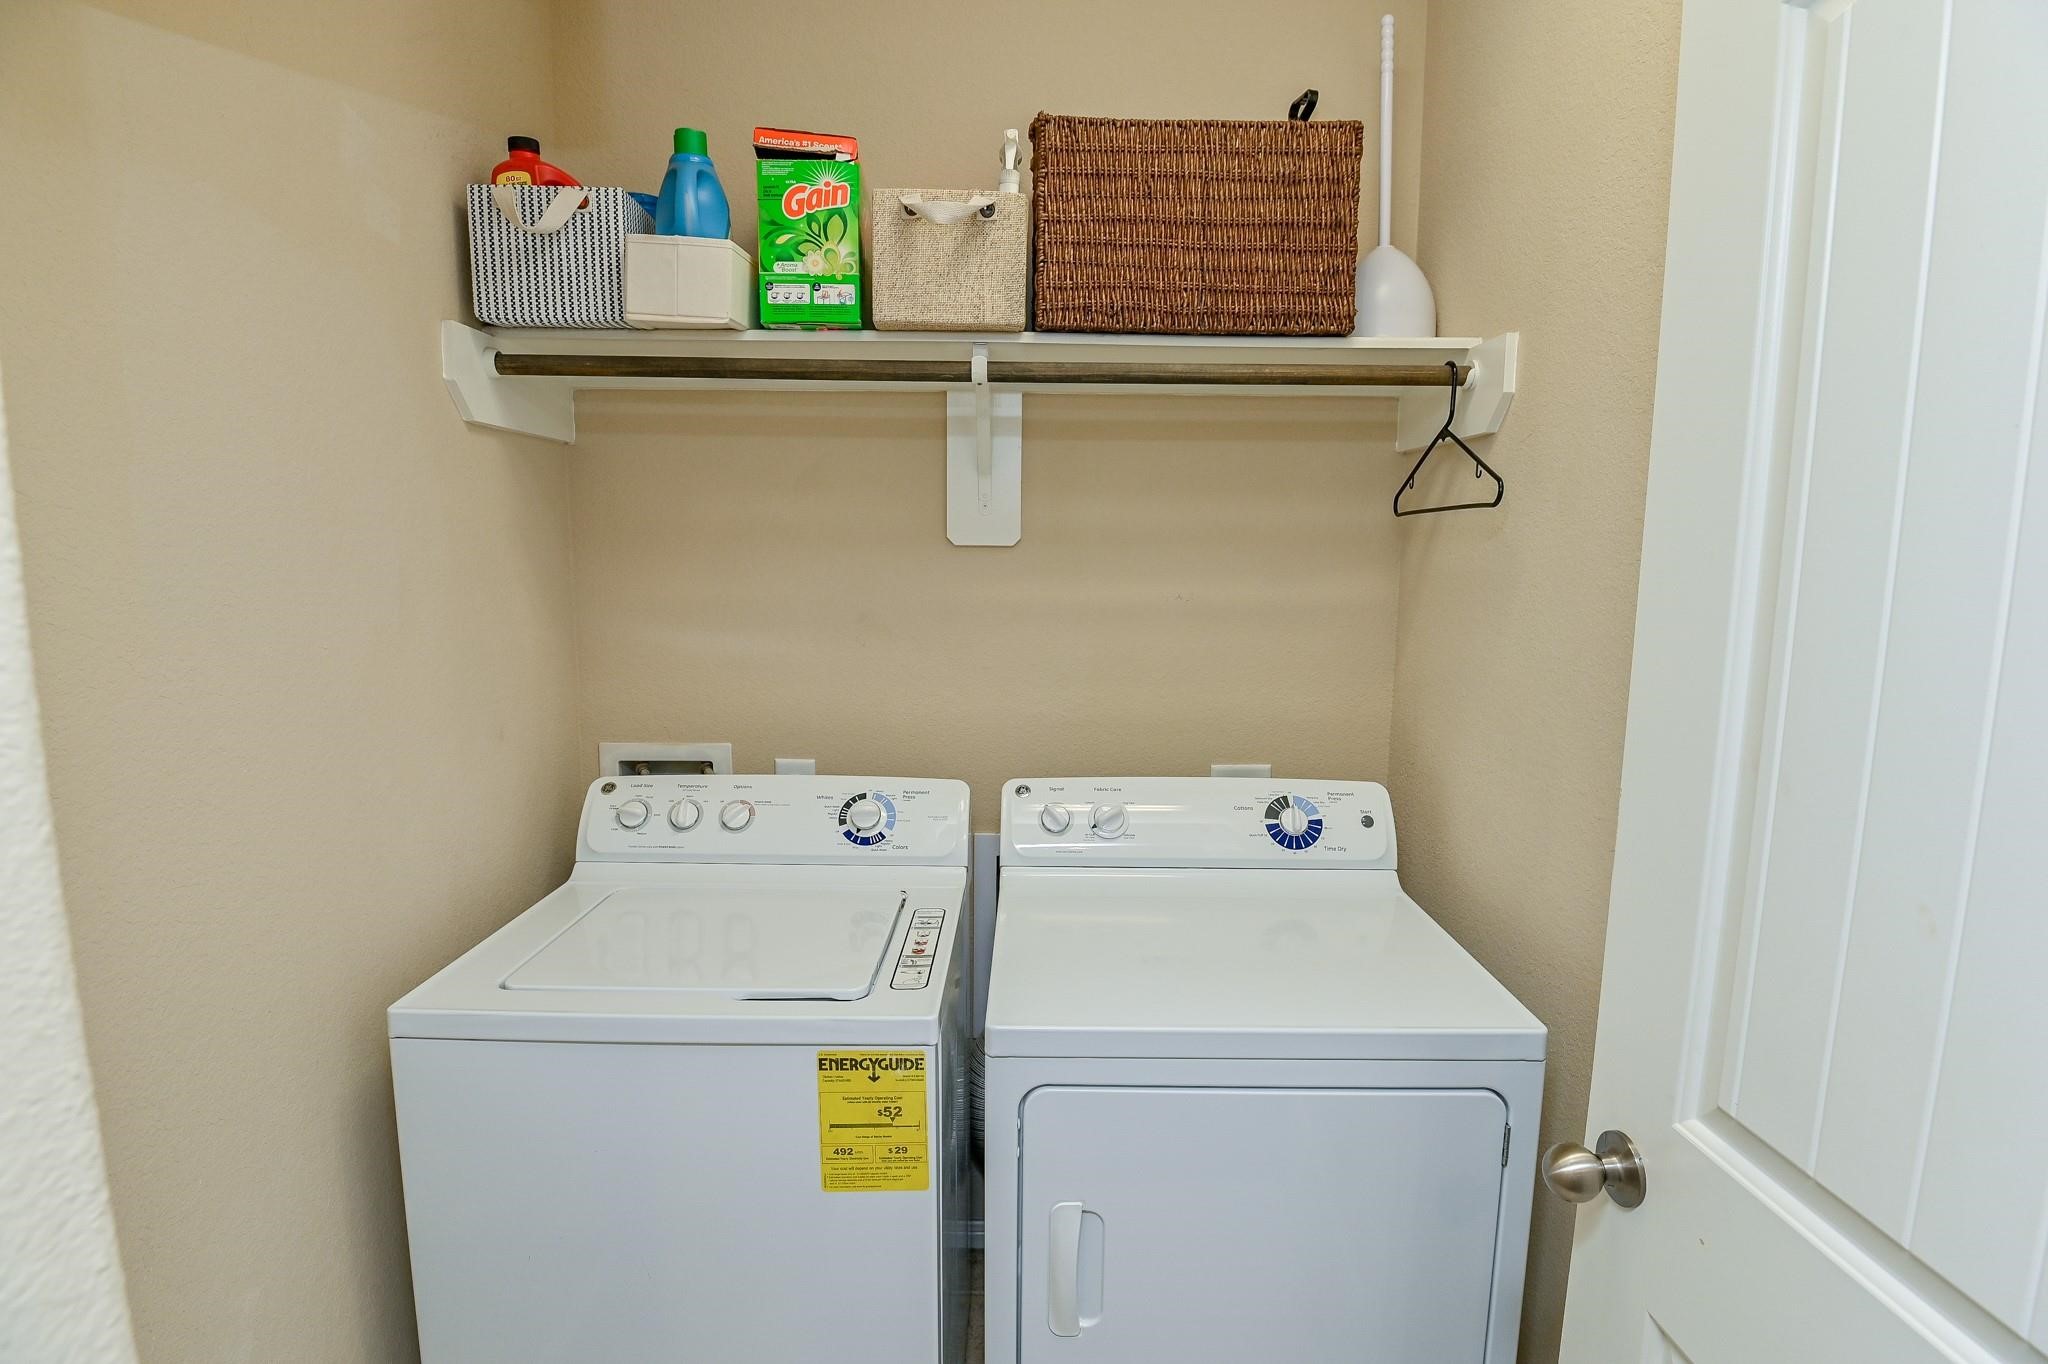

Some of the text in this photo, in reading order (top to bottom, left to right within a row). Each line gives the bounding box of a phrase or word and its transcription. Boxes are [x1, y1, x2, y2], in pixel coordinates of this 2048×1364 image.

[759, 136, 801, 147] America's
[783, 180, 849, 218] Gain
[818, 1058, 924, 1071] ENERGYGUIDE
[878, 1106, 903, 1117] $52
[833, 1148, 854, 1156] 492
